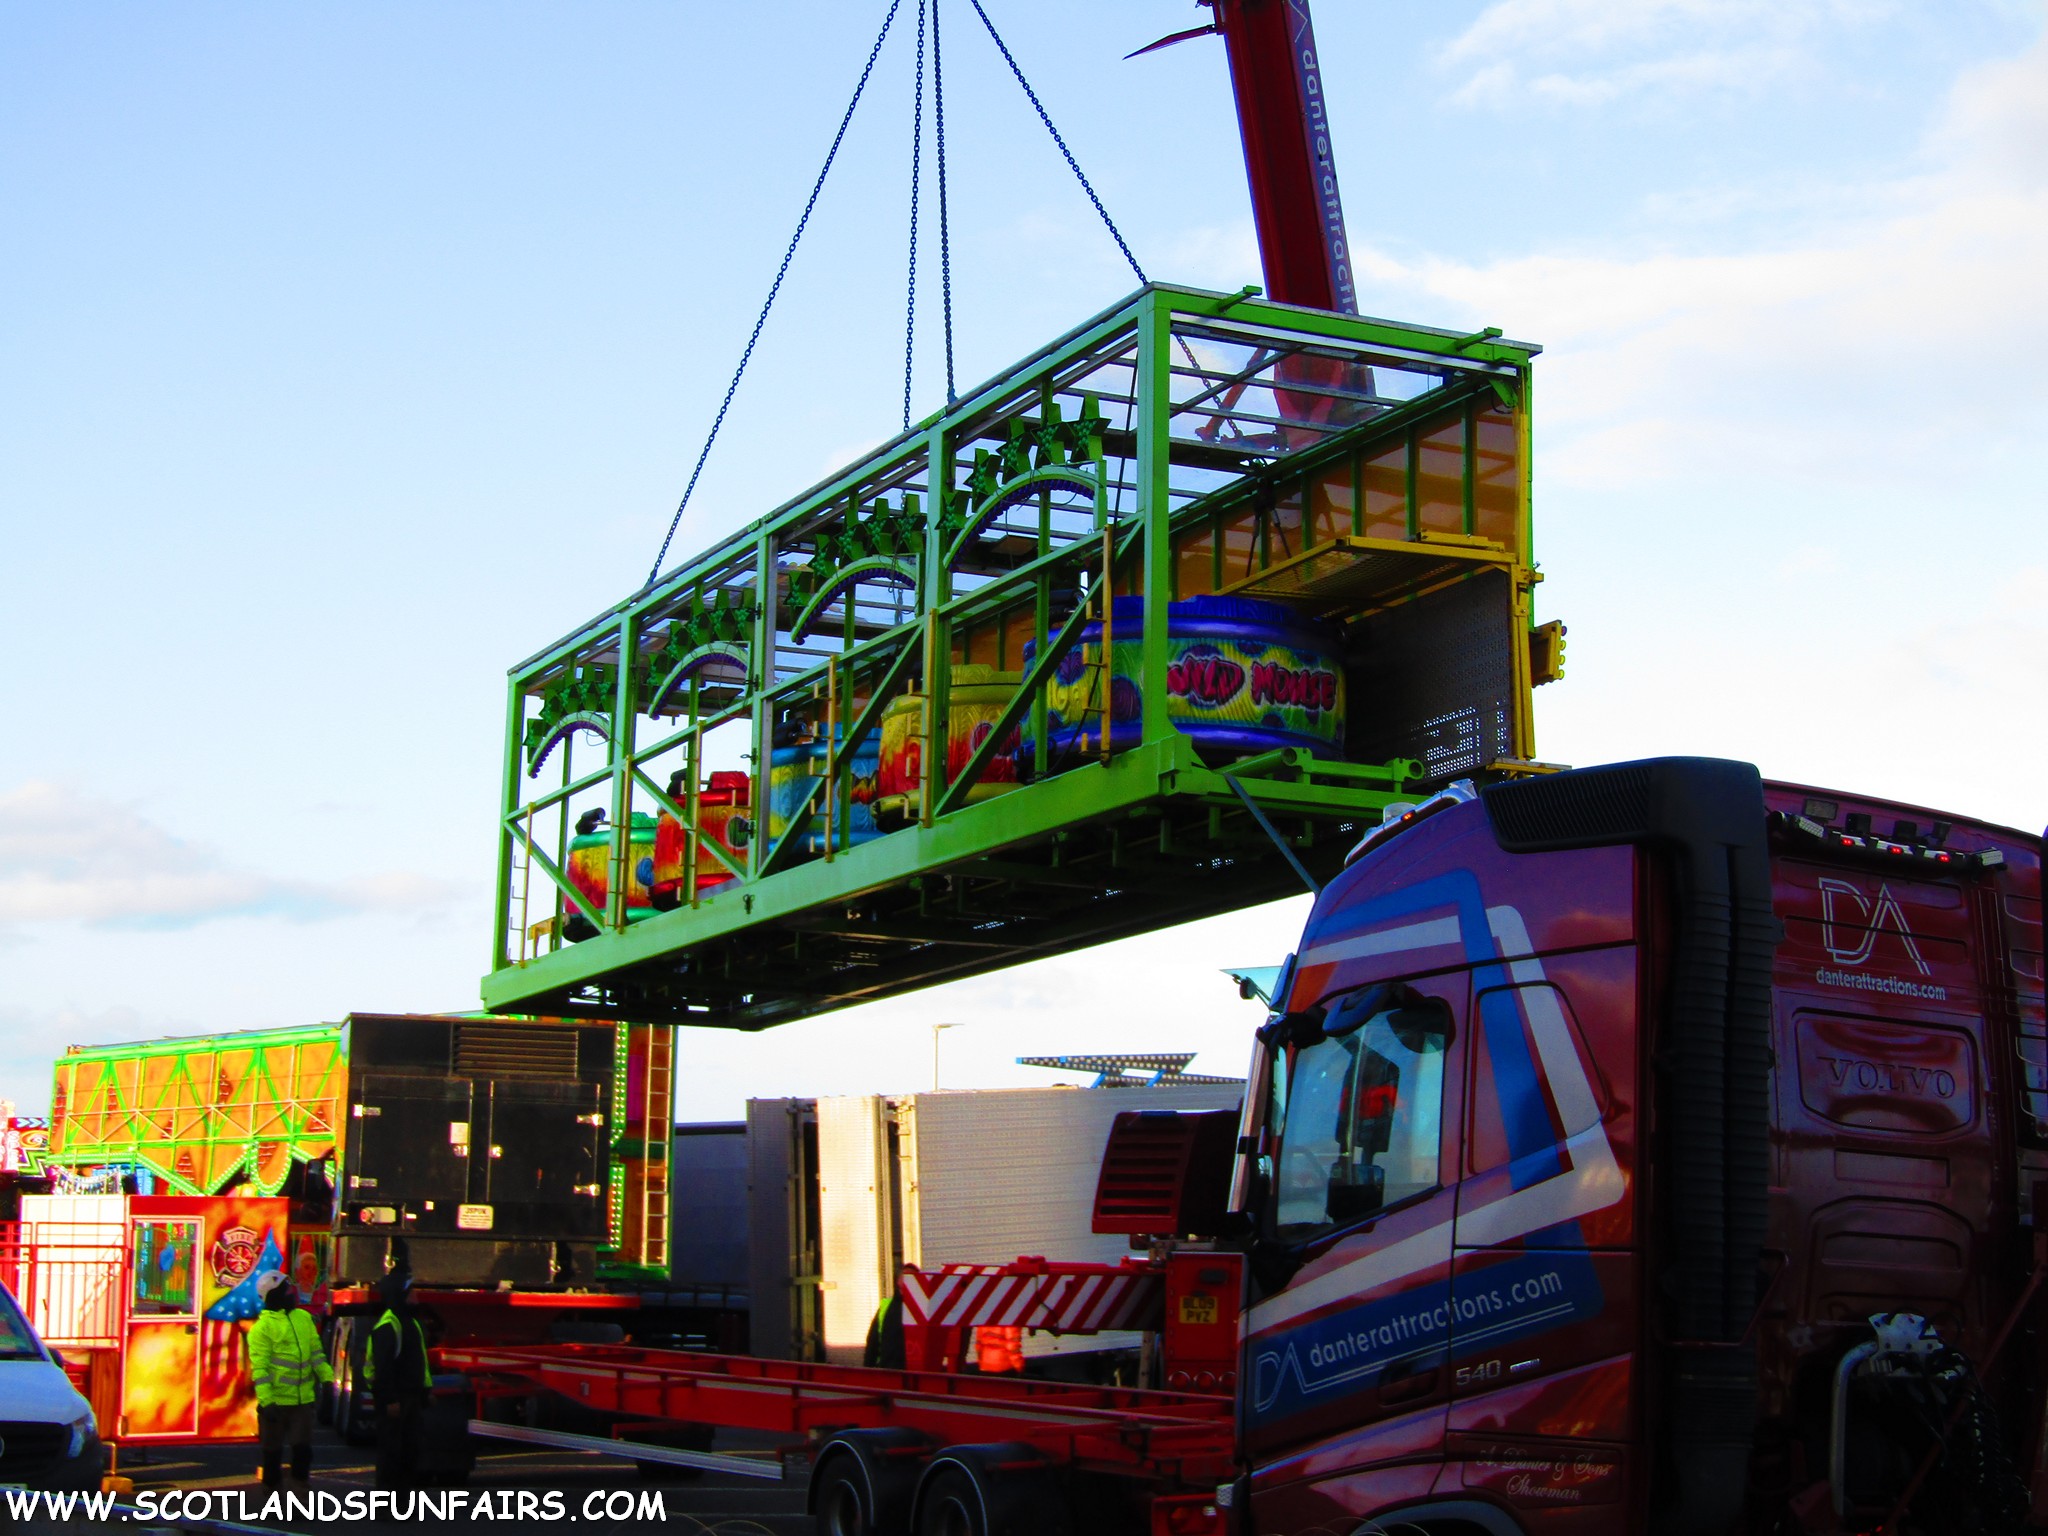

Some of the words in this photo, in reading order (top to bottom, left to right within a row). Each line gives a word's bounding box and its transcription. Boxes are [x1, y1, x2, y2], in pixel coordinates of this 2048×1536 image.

[1302, 49, 1356, 315] danterattracti
[1251, 661, 1337, 711] MOUSE
[1816, 966, 1946, 1001] danterattractions.com
[1818, 1057, 1957, 1099] VOLVO
[1308, 1268, 1564, 1368] danterattractions.com
[1456, 1359, 1502, 1386] 540
[1505, 1473, 1581, 1500] Showman
